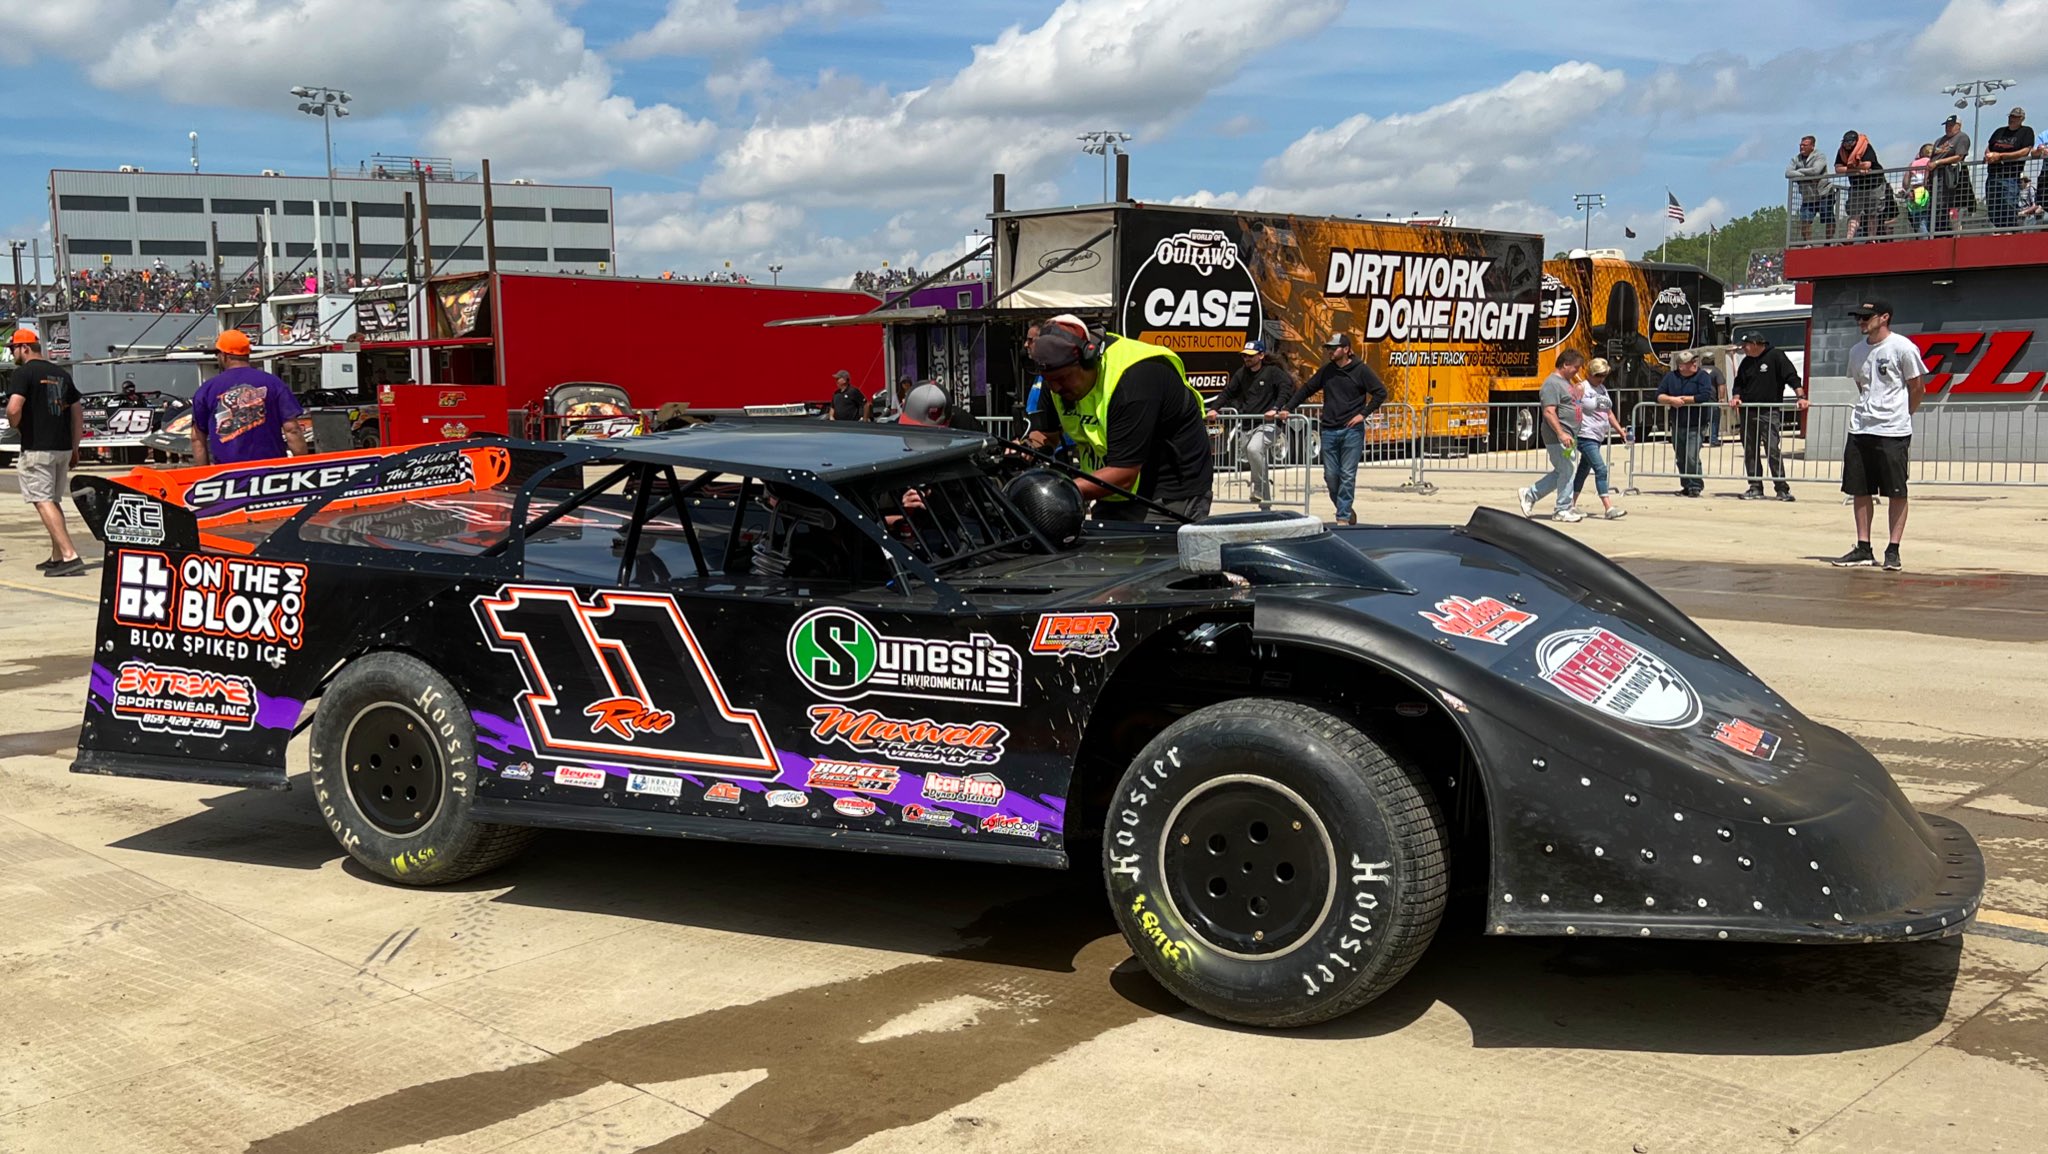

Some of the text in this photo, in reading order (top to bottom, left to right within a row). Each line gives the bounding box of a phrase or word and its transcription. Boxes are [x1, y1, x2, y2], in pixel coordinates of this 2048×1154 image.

[1191, 232, 1222, 241] WORLD OF
[1157, 238, 1235, 276] OUTLAWS
[1326, 252, 1401, 296] DIRT
[1404, 256, 1491, 299] WORK
[1144, 288, 1254, 327] CASE
[1366, 298, 1535, 341] DONE RIGHT
[1540, 298, 1573, 319] SE
[1654, 313, 1692, 332] CASE
[1154, 334, 1242, 349] CONSTRUCTION
[1389, 351, 1530, 366] FROM THE TRACK TO THE JOBSITE
[1908, 330, 2048, 394] EL
[1187, 374, 1227, 388] MODELS
[109, 410, 152, 433] 46
[386, 463, 456, 484] THE BETTER
[407, 450, 458, 467] SLICKER
[109, 498, 162, 530] ATC
[183, 559, 281, 595] ON THE
[181, 590, 277, 637] BLOX
[1049, 617, 1113, 635] RBR
[131, 629, 287, 665] BLOX SPIKED ICE
[810, 616, 1010, 687] Sunesis
[117, 667, 251, 706] EXTREME
[470, 584, 783, 782] 11
[901, 673, 984, 692] ENVIRONMENTAL
[1606, 667, 1658, 714] RACING SHOCKS
[117, 696, 249, 717] SPORTSWEAR, INC.
[142, 714, 222, 730] 859-428-2796
[413, 685, 470, 797] Hoosier
[811, 708, 999, 749] Maxwell
[876, 740, 988, 757] TRUCKING
[891, 749, 968, 763] VERONA KY
[560, 768, 603, 779] Beyea
[311, 746, 361, 850] Hoosier
[1109, 746, 1182, 883] Hoosier
[1303, 853, 1393, 996] Hoosier
